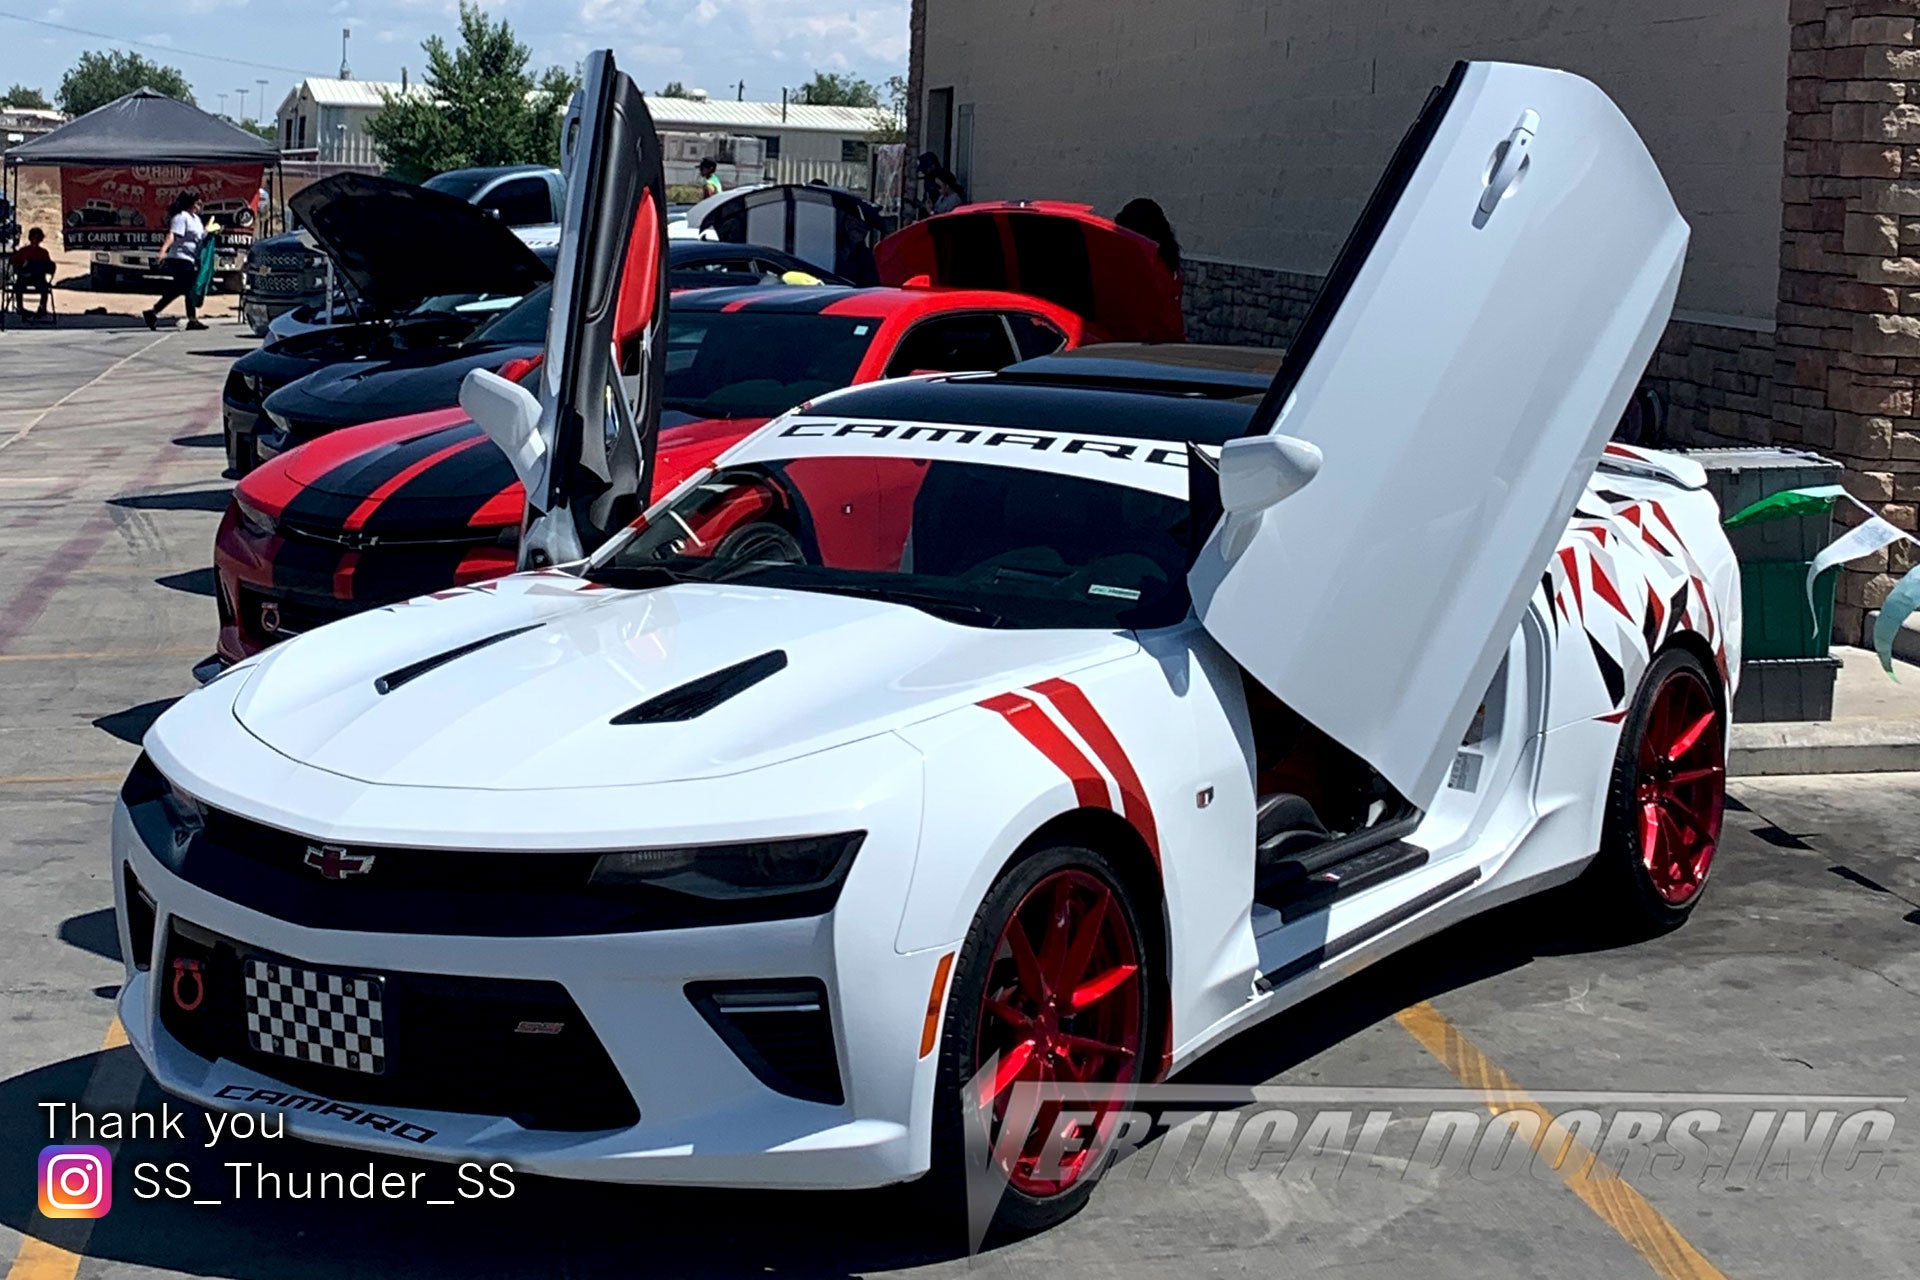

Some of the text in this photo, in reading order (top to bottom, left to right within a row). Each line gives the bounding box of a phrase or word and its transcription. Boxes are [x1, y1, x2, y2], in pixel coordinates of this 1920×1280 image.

[68, 233, 84, 243] WE
[88, 233, 120, 243] CARRY
[124, 233, 148, 243] THE
[220, 234, 253, 245] TRUST
[213, 1084, 438, 1144] CAMARO
